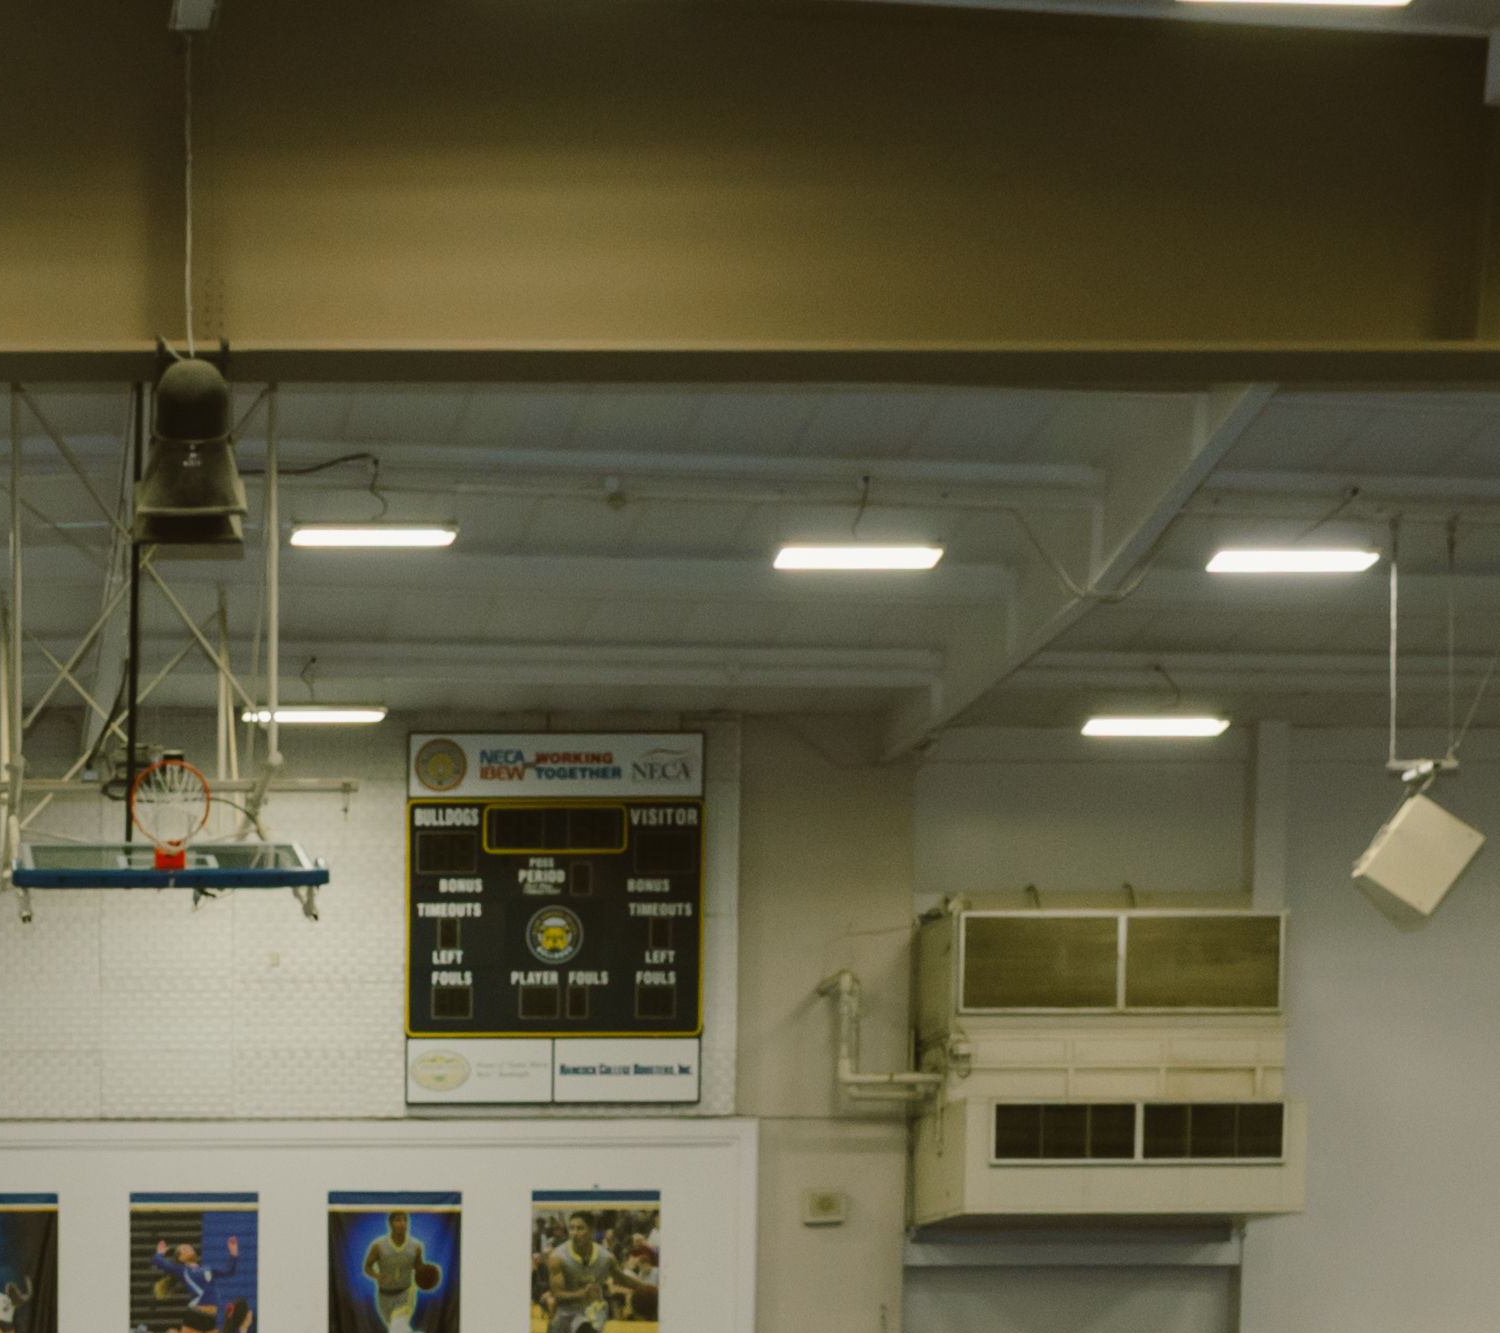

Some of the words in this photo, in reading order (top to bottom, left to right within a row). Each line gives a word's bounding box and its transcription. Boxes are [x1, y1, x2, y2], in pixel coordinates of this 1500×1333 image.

[415, 808, 479, 826] BULLDOGS
[630, 808, 698, 825] VISITOR
[519, 870, 565, 884] PERIOD
[440, 879, 482, 892] BONUS
[627, 879, 670, 892] BONUS
[417, 904, 482, 917] TIMEOUTS
[629, 903, 692, 917] TIMEOUTS
[432, 951, 463, 964] LEFT
[645, 951, 674, 964] LEFT
[432, 972, 472, 985] FOULS
[511, 972, 558, 985] PLAYER
[569, 972, 608, 985] FOULS
[636, 971, 676, 984] FOULS
